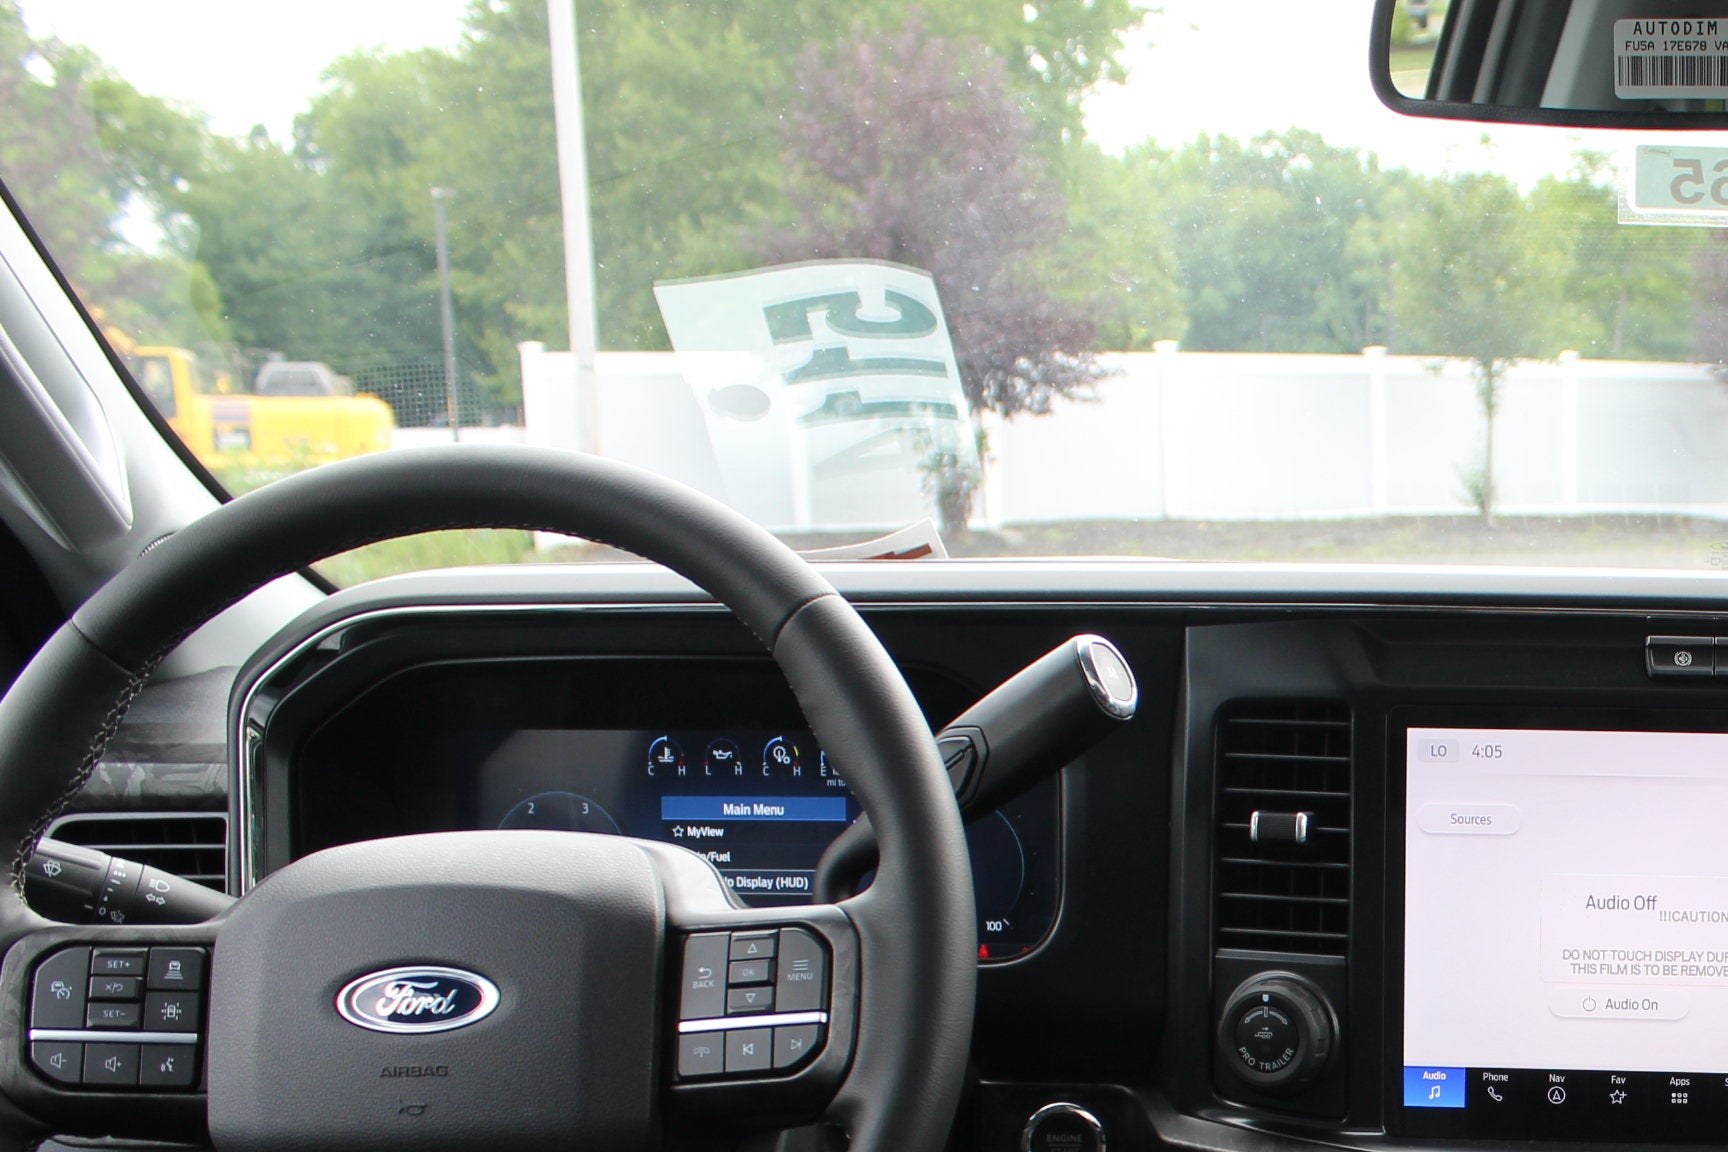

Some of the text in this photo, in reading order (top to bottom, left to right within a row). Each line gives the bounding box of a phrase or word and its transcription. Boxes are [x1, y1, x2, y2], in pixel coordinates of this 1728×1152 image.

[1633, 20, 1719, 36] AUTODIM
[1625, 40, 1655, 51] FU5A
[1663, 40, 1707, 51] 17E678
[1431, 745, 1502, 758] LO 4:05
[527, 802, 535, 814] 2
[581, 802, 589, 814] 3
[723, 803, 785, 817] Main Menu
[1450, 813, 1492, 825] Sources
[687, 826, 724, 839] MyView
[736, 876, 773, 890] Display
[776, 876, 808, 890] (HUD)
[1585, 895, 1657, 911] Audio Off
[985, 920, 1003, 932] 100
[1562, 949, 1581, 961] DO
[1583, 950, 1608, 961] NOT
[1612, 951, 1652, 962] TOUCH
[1655, 951, 1703, 963] DISPLAY
[1570, 963, 1597, 975] THIS
[1600, 964, 1628, 976] FILM
[1630, 964, 1641, 976] IS
[1643, 965, 1660, 976] TO
[1662, 965, 1678, 976] BE
[787, 972, 813, 981] MENU
[692, 980, 714, 989] BACK
[375, 981, 457, 1016] Ford
[1605, 998, 1658, 1011] Audio On
[1238, 1046, 1294, 1071] PRO TRAILER
[379, 1065, 449, 1078] AIRBAG
[1422, 1071, 1446, 1080] Audio
[1482, 1072, 1509, 1082] Phone
[1549, 1074, 1565, 1083] Nav
[1611, 1075, 1626, 1084] Fav
[1669, 1076, 1690, 1087] Apps
[1046, 1134, 1083, 1143] ENGINE
